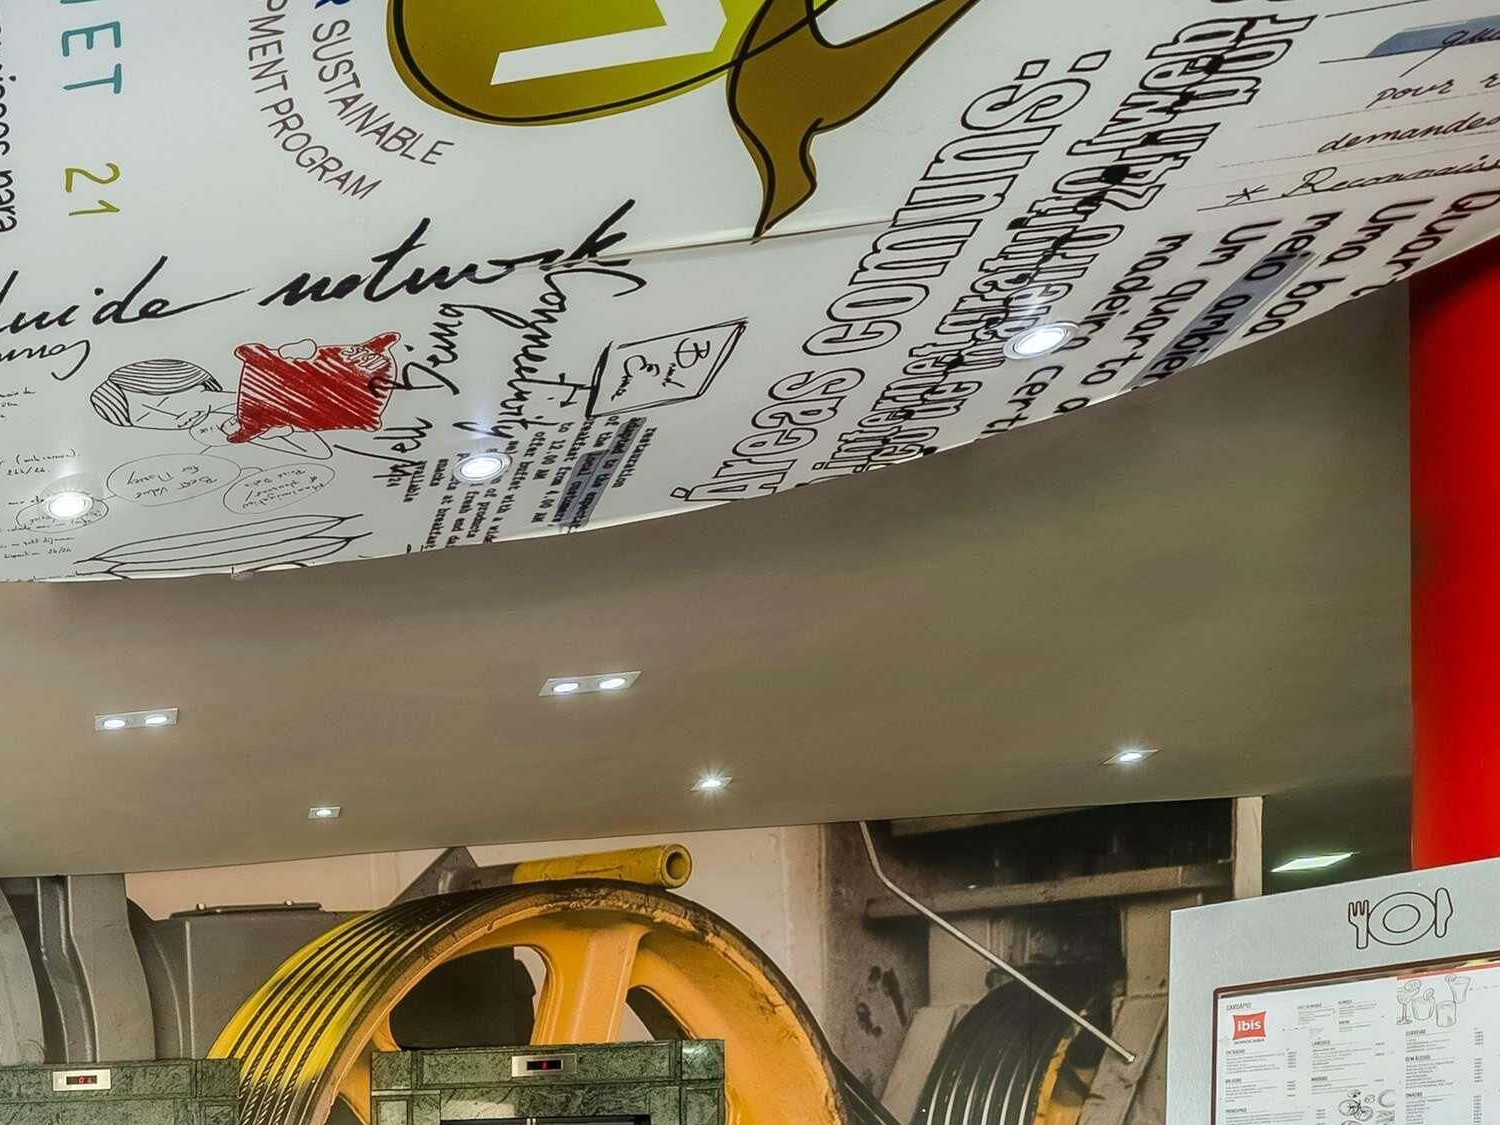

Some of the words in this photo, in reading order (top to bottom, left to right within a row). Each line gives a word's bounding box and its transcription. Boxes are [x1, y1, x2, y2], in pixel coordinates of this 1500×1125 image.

[60, 0, 122, 94] ET
[312, 19, 455, 165] SUSTAINABLE
[1365, 78, 1455, 109] pour
[260, 98, 383, 200] PROGRAM
[64, 162, 121, 216] 21
[1196, 218, 1284, 269] Um
[1242, 210, 1344, 283] meio
[1314, 198, 1435, 269] Uma
[670, 368, 866, 502] Áreas
[802, 50, 1110, 356] comuns:
[1243, 277, 1346, 338] boa
[1080, 278, 1208, 387] quarto
[1236, 1016, 1262, 1032] ibis
